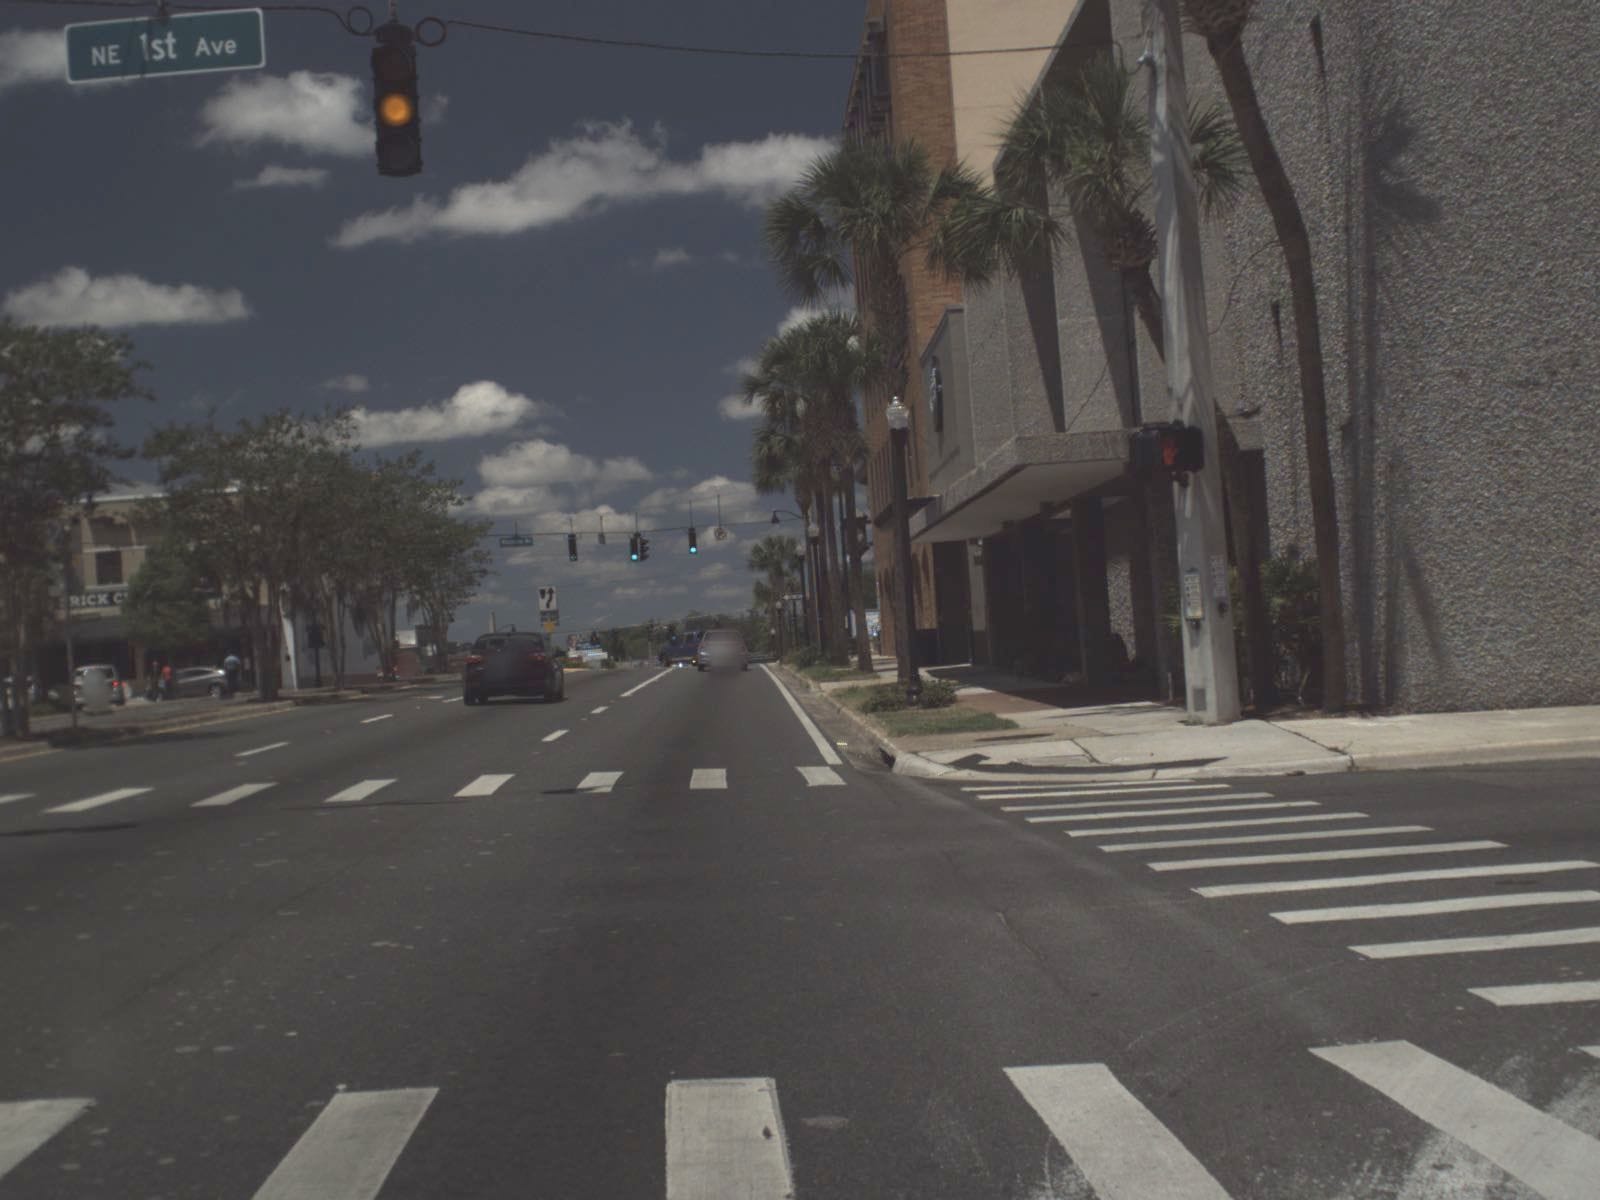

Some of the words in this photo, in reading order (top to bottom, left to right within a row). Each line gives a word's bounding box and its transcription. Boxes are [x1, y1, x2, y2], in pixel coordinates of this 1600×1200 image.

[91, 44, 121, 66] NE
[139, 31, 177, 61] 1st
[194, 37, 237, 57] Ave
[67, 593, 110, 607] RICK
